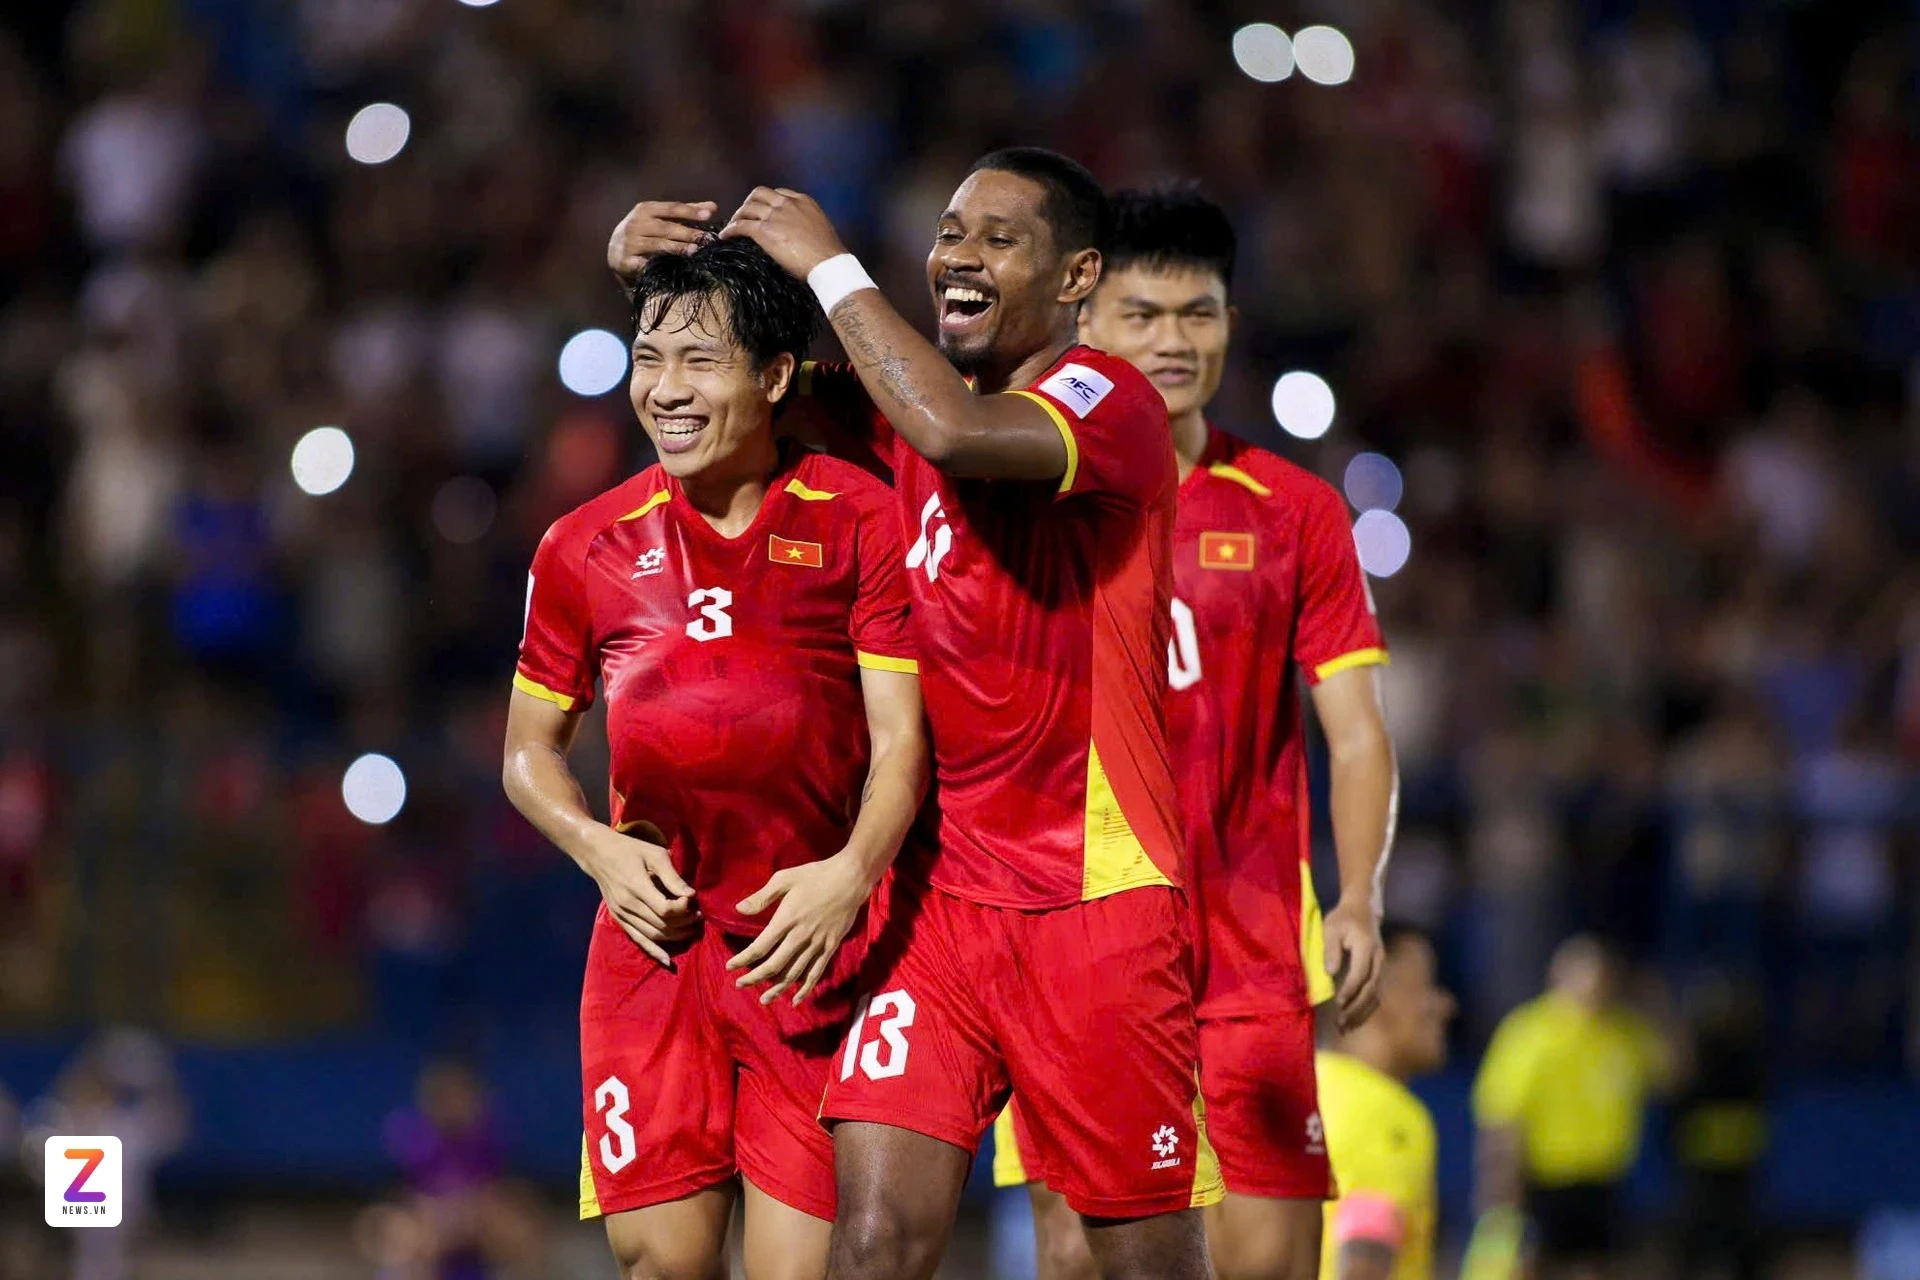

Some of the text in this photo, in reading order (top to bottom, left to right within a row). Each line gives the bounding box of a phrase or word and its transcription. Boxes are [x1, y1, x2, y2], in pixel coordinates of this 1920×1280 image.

[1059, 377, 1099, 400] AFC
[685, 586, 733, 642] 3
[840, 988, 917, 1083] 13
[595, 1075, 637, 1175] 3
